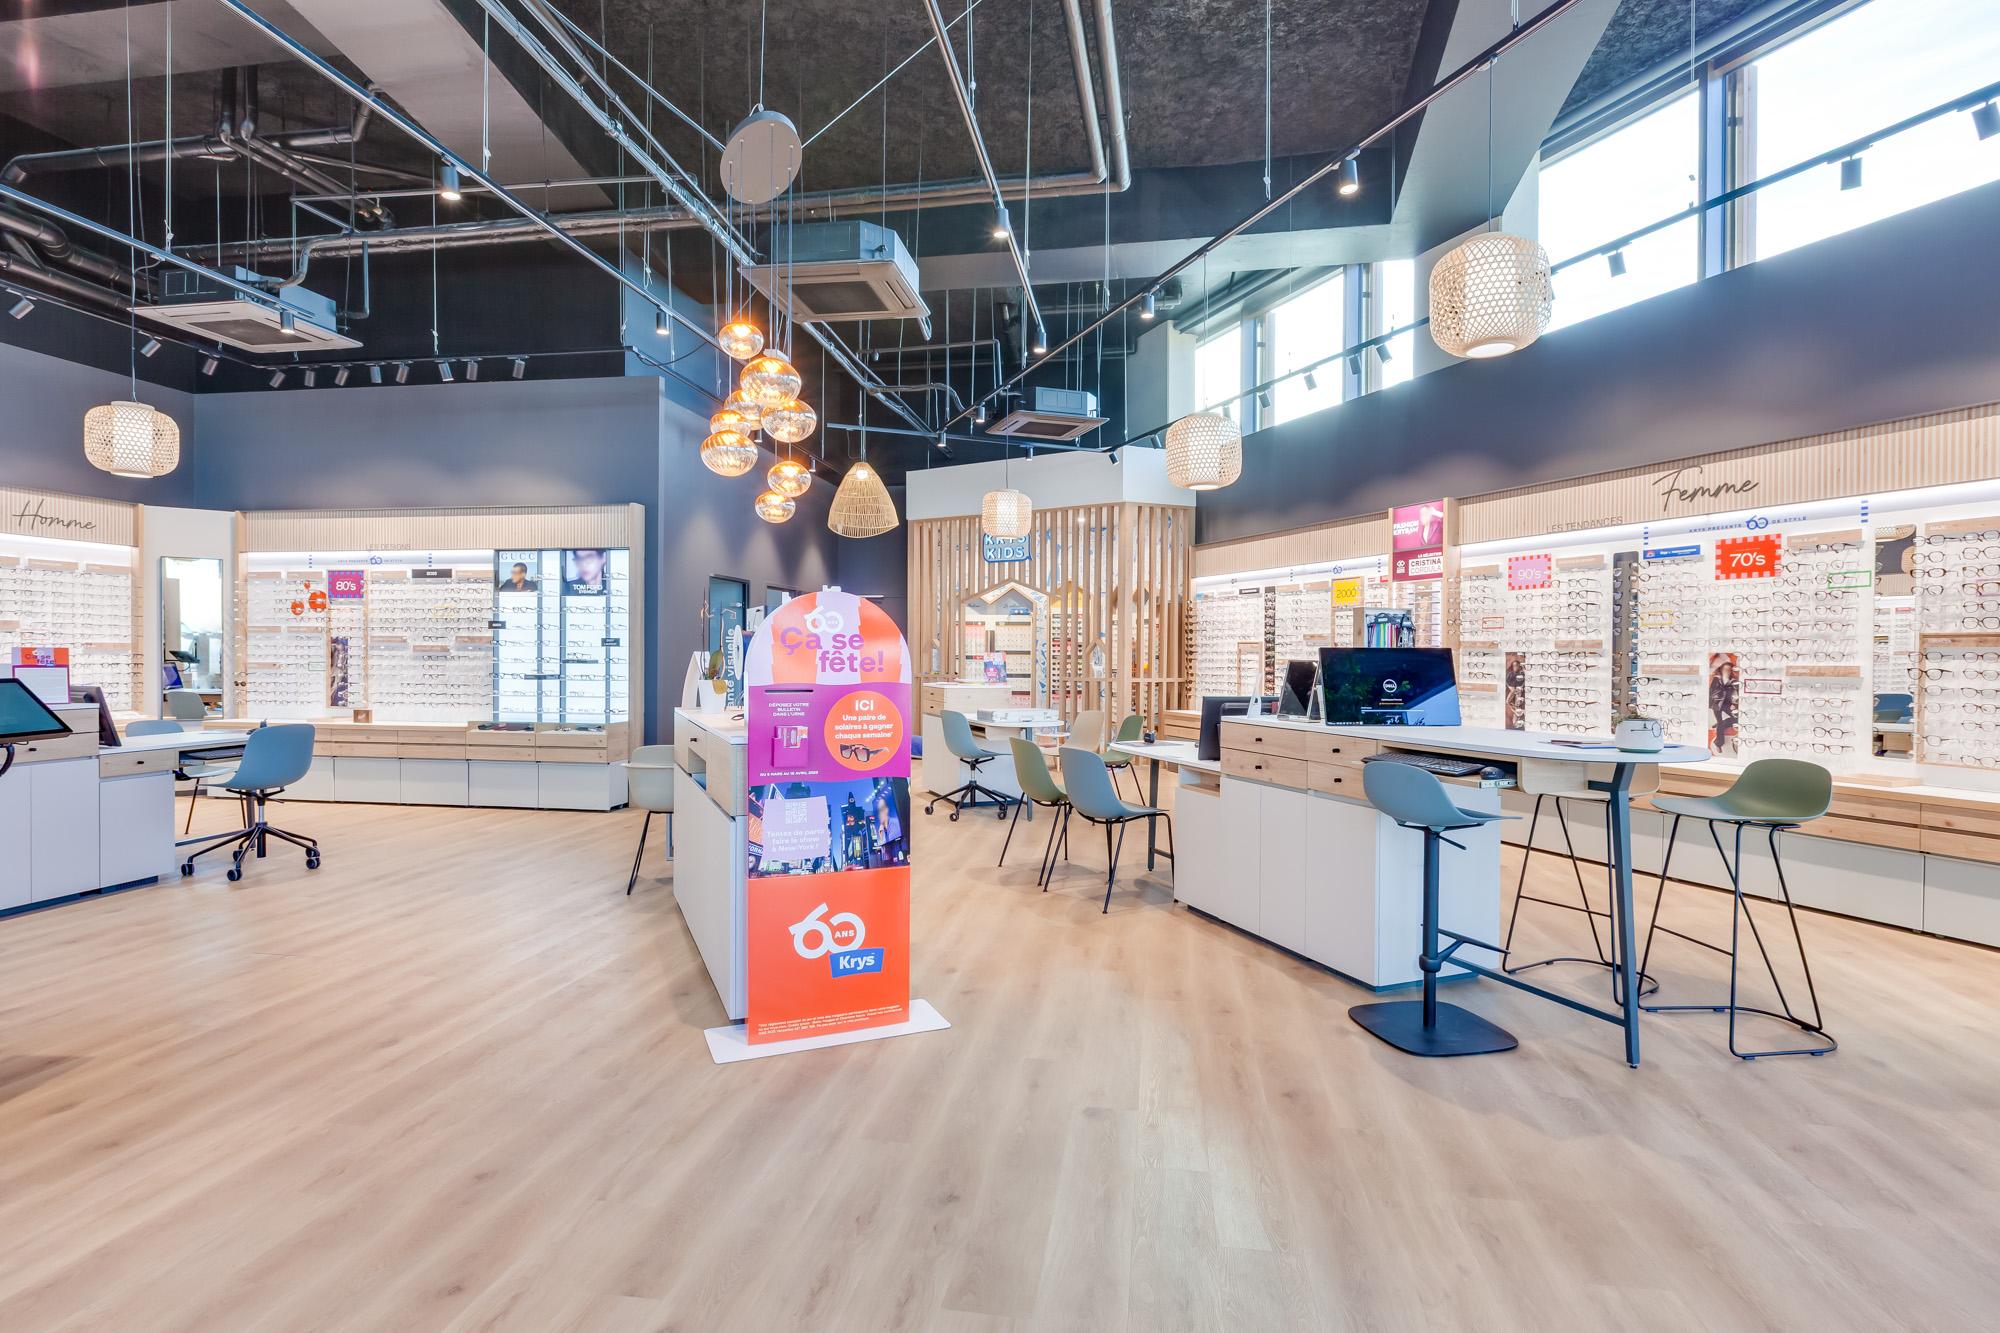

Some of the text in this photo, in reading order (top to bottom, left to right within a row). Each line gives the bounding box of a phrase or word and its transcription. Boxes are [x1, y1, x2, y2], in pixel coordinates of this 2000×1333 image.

[1652, 466, 1760, 512] Femme
[12, 498, 96, 530] Homme
[1546, 516, 1624, 534] LES TENDANCES
[987, 546, 1024, 560] KIDS
[1730, 552, 1766, 568] 70's
[1410, 558, 1441, 567] CRISTINA
[1518, 568, 1542, 580] 90's
[336, 581, 356, 591] 80's
[804, 605, 844, 634] 60
[780, 626, 864, 656] Ça se
[725, 628, 735, 677] visuelle
[819, 650, 884, 672] fête!
[855, 700, 874, 711] ICI
[788, 902, 866, 959] 60
[834, 930, 854, 938] ANS
[840, 955, 875, 970] Krys
